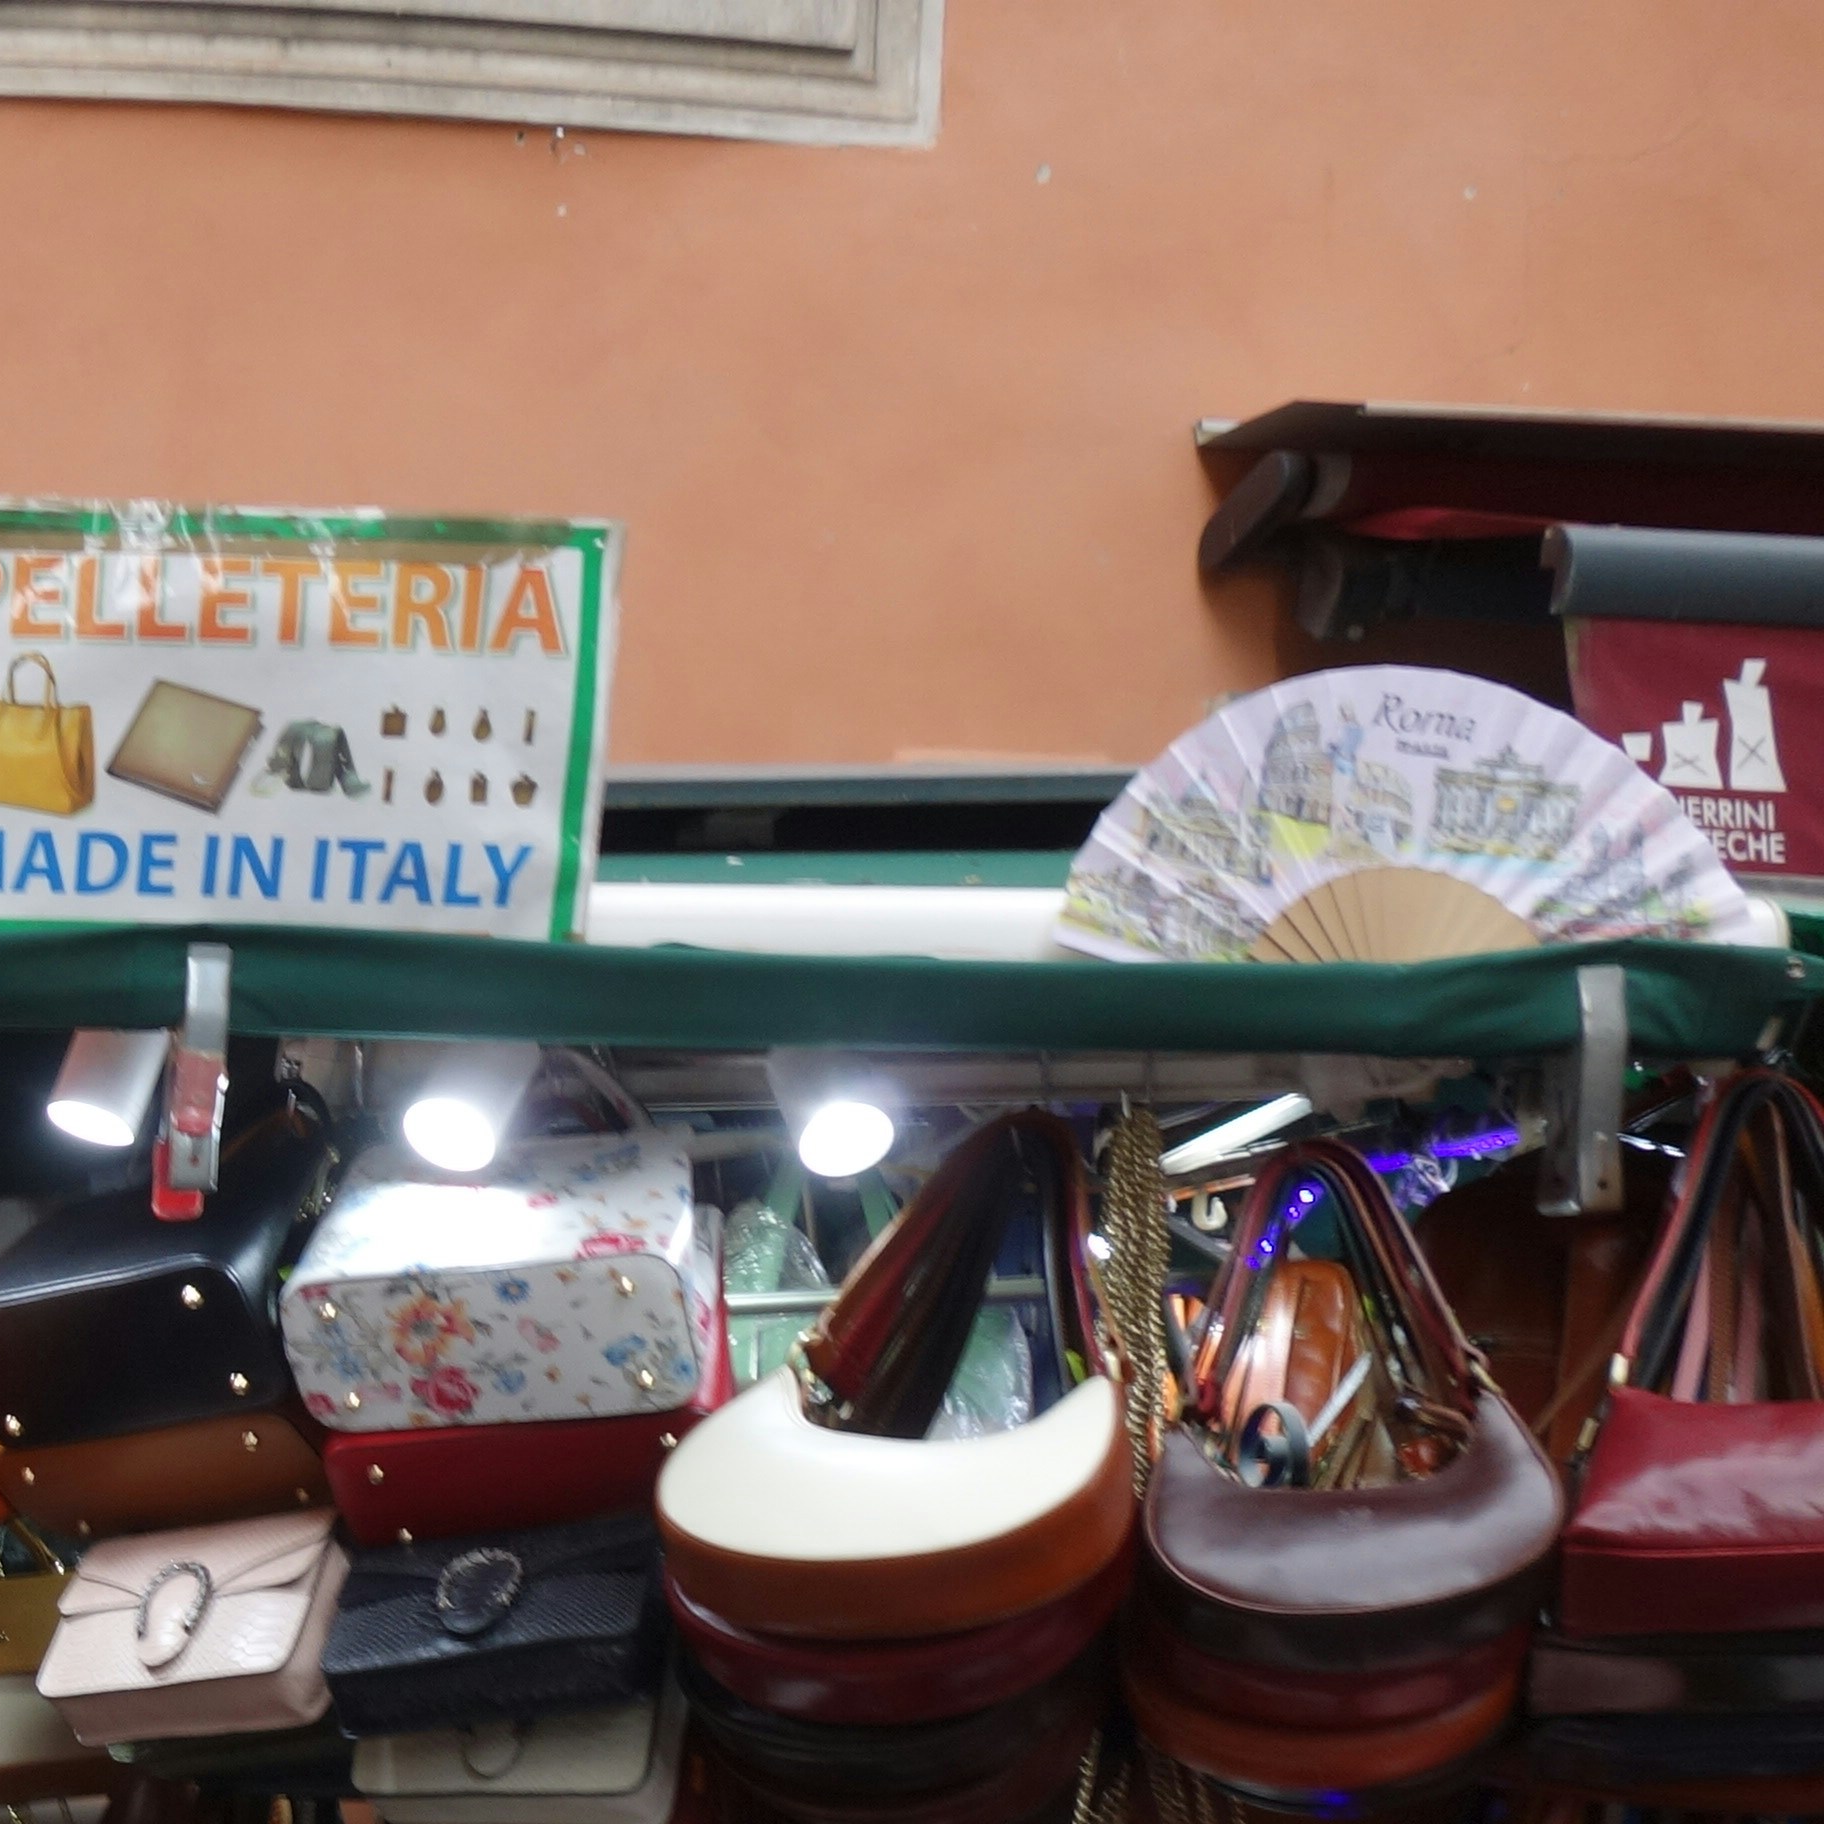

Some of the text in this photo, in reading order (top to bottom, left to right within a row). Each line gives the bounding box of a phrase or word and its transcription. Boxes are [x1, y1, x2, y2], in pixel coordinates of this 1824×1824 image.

[1372, 691, 1476, 743] Roma
[199, 832, 286, 901] IN
[309, 837, 535, 908] ITALY
